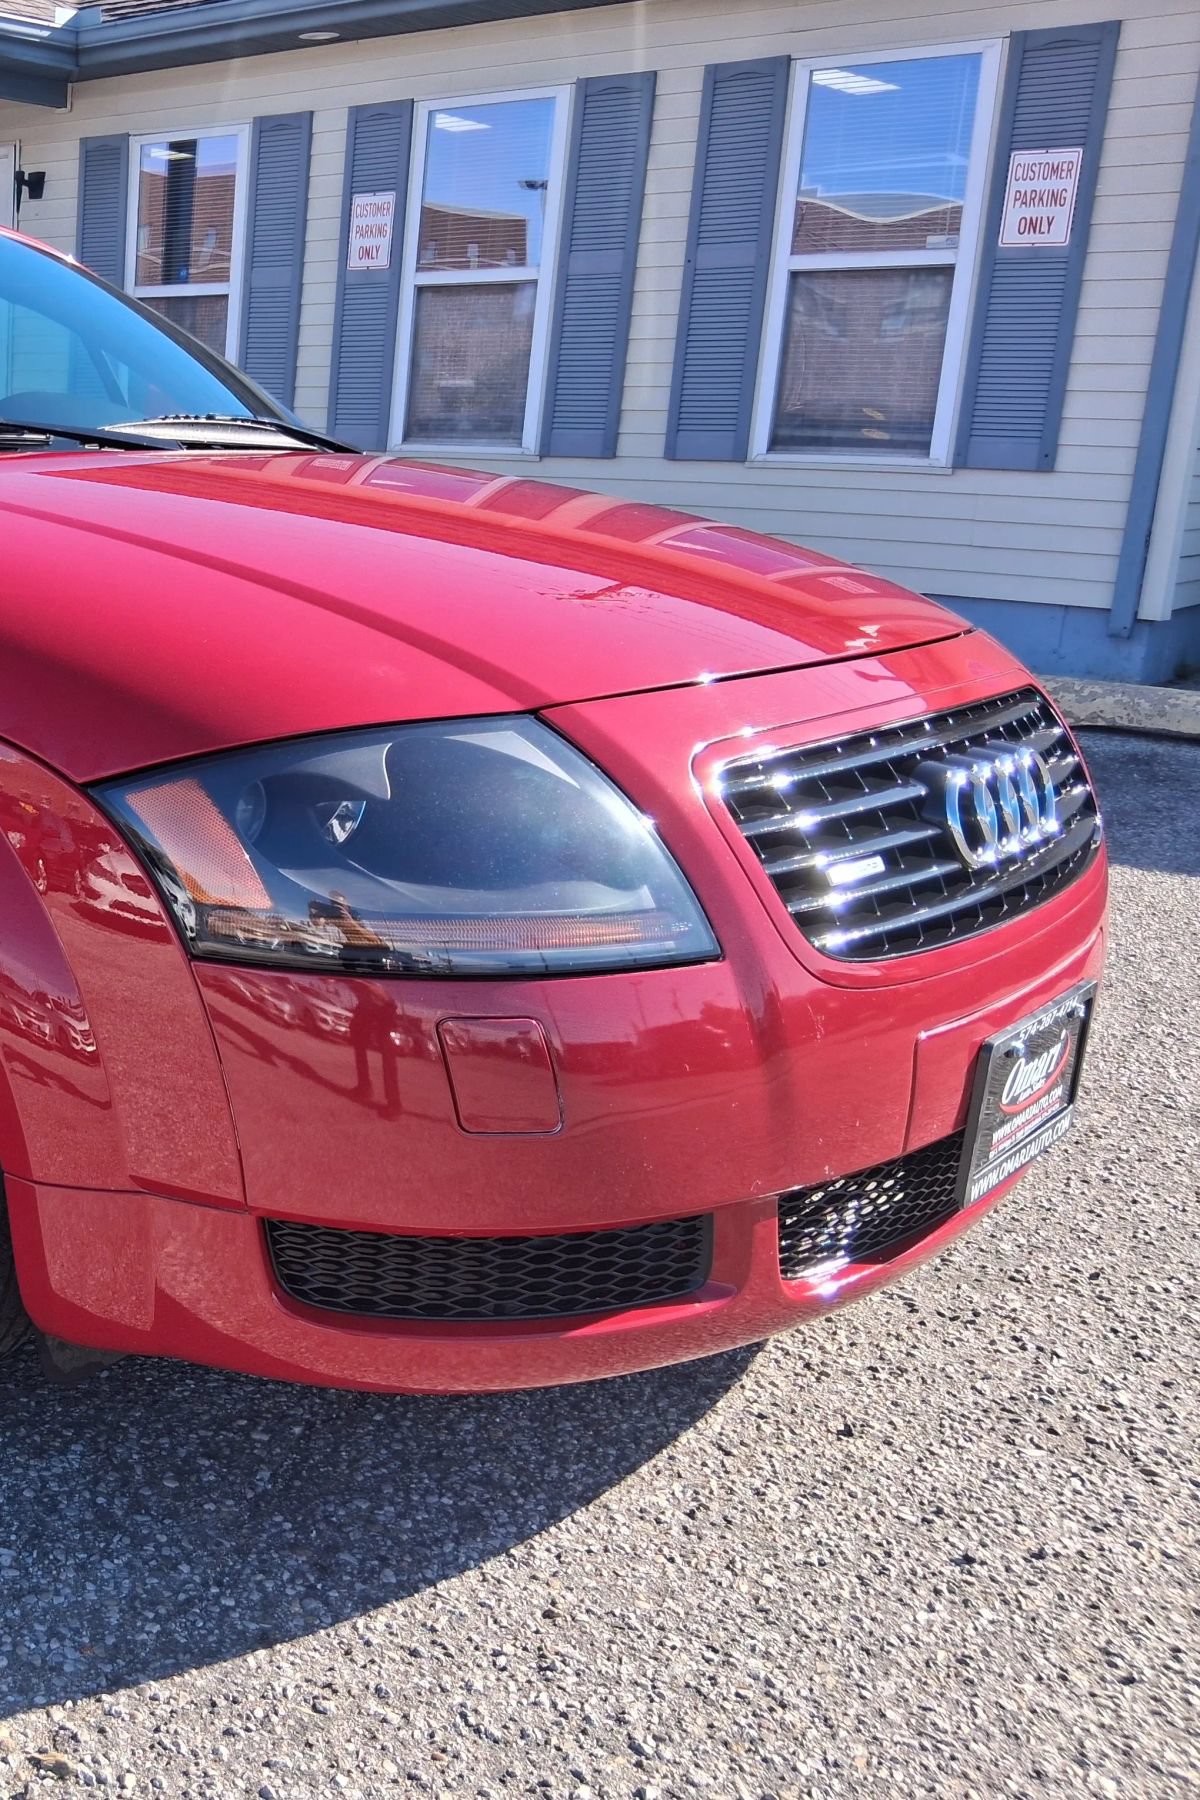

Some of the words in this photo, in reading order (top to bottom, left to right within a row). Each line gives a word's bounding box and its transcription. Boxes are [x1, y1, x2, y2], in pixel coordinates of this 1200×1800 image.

[1014, 161, 1074, 182] CUSTOMER
[1013, 188, 1068, 208] PARKING
[356, 201, 391, 218] CUSTOMER
[355, 223, 387, 239] PARKING
[1017, 216, 1055, 235] ONLY
[358, 245, 381, 261] ONLY
[1001, 1028, 1067, 1105] Omari
[970, 1114, 1071, 1202] WWW.OMARIAUTO.COM
